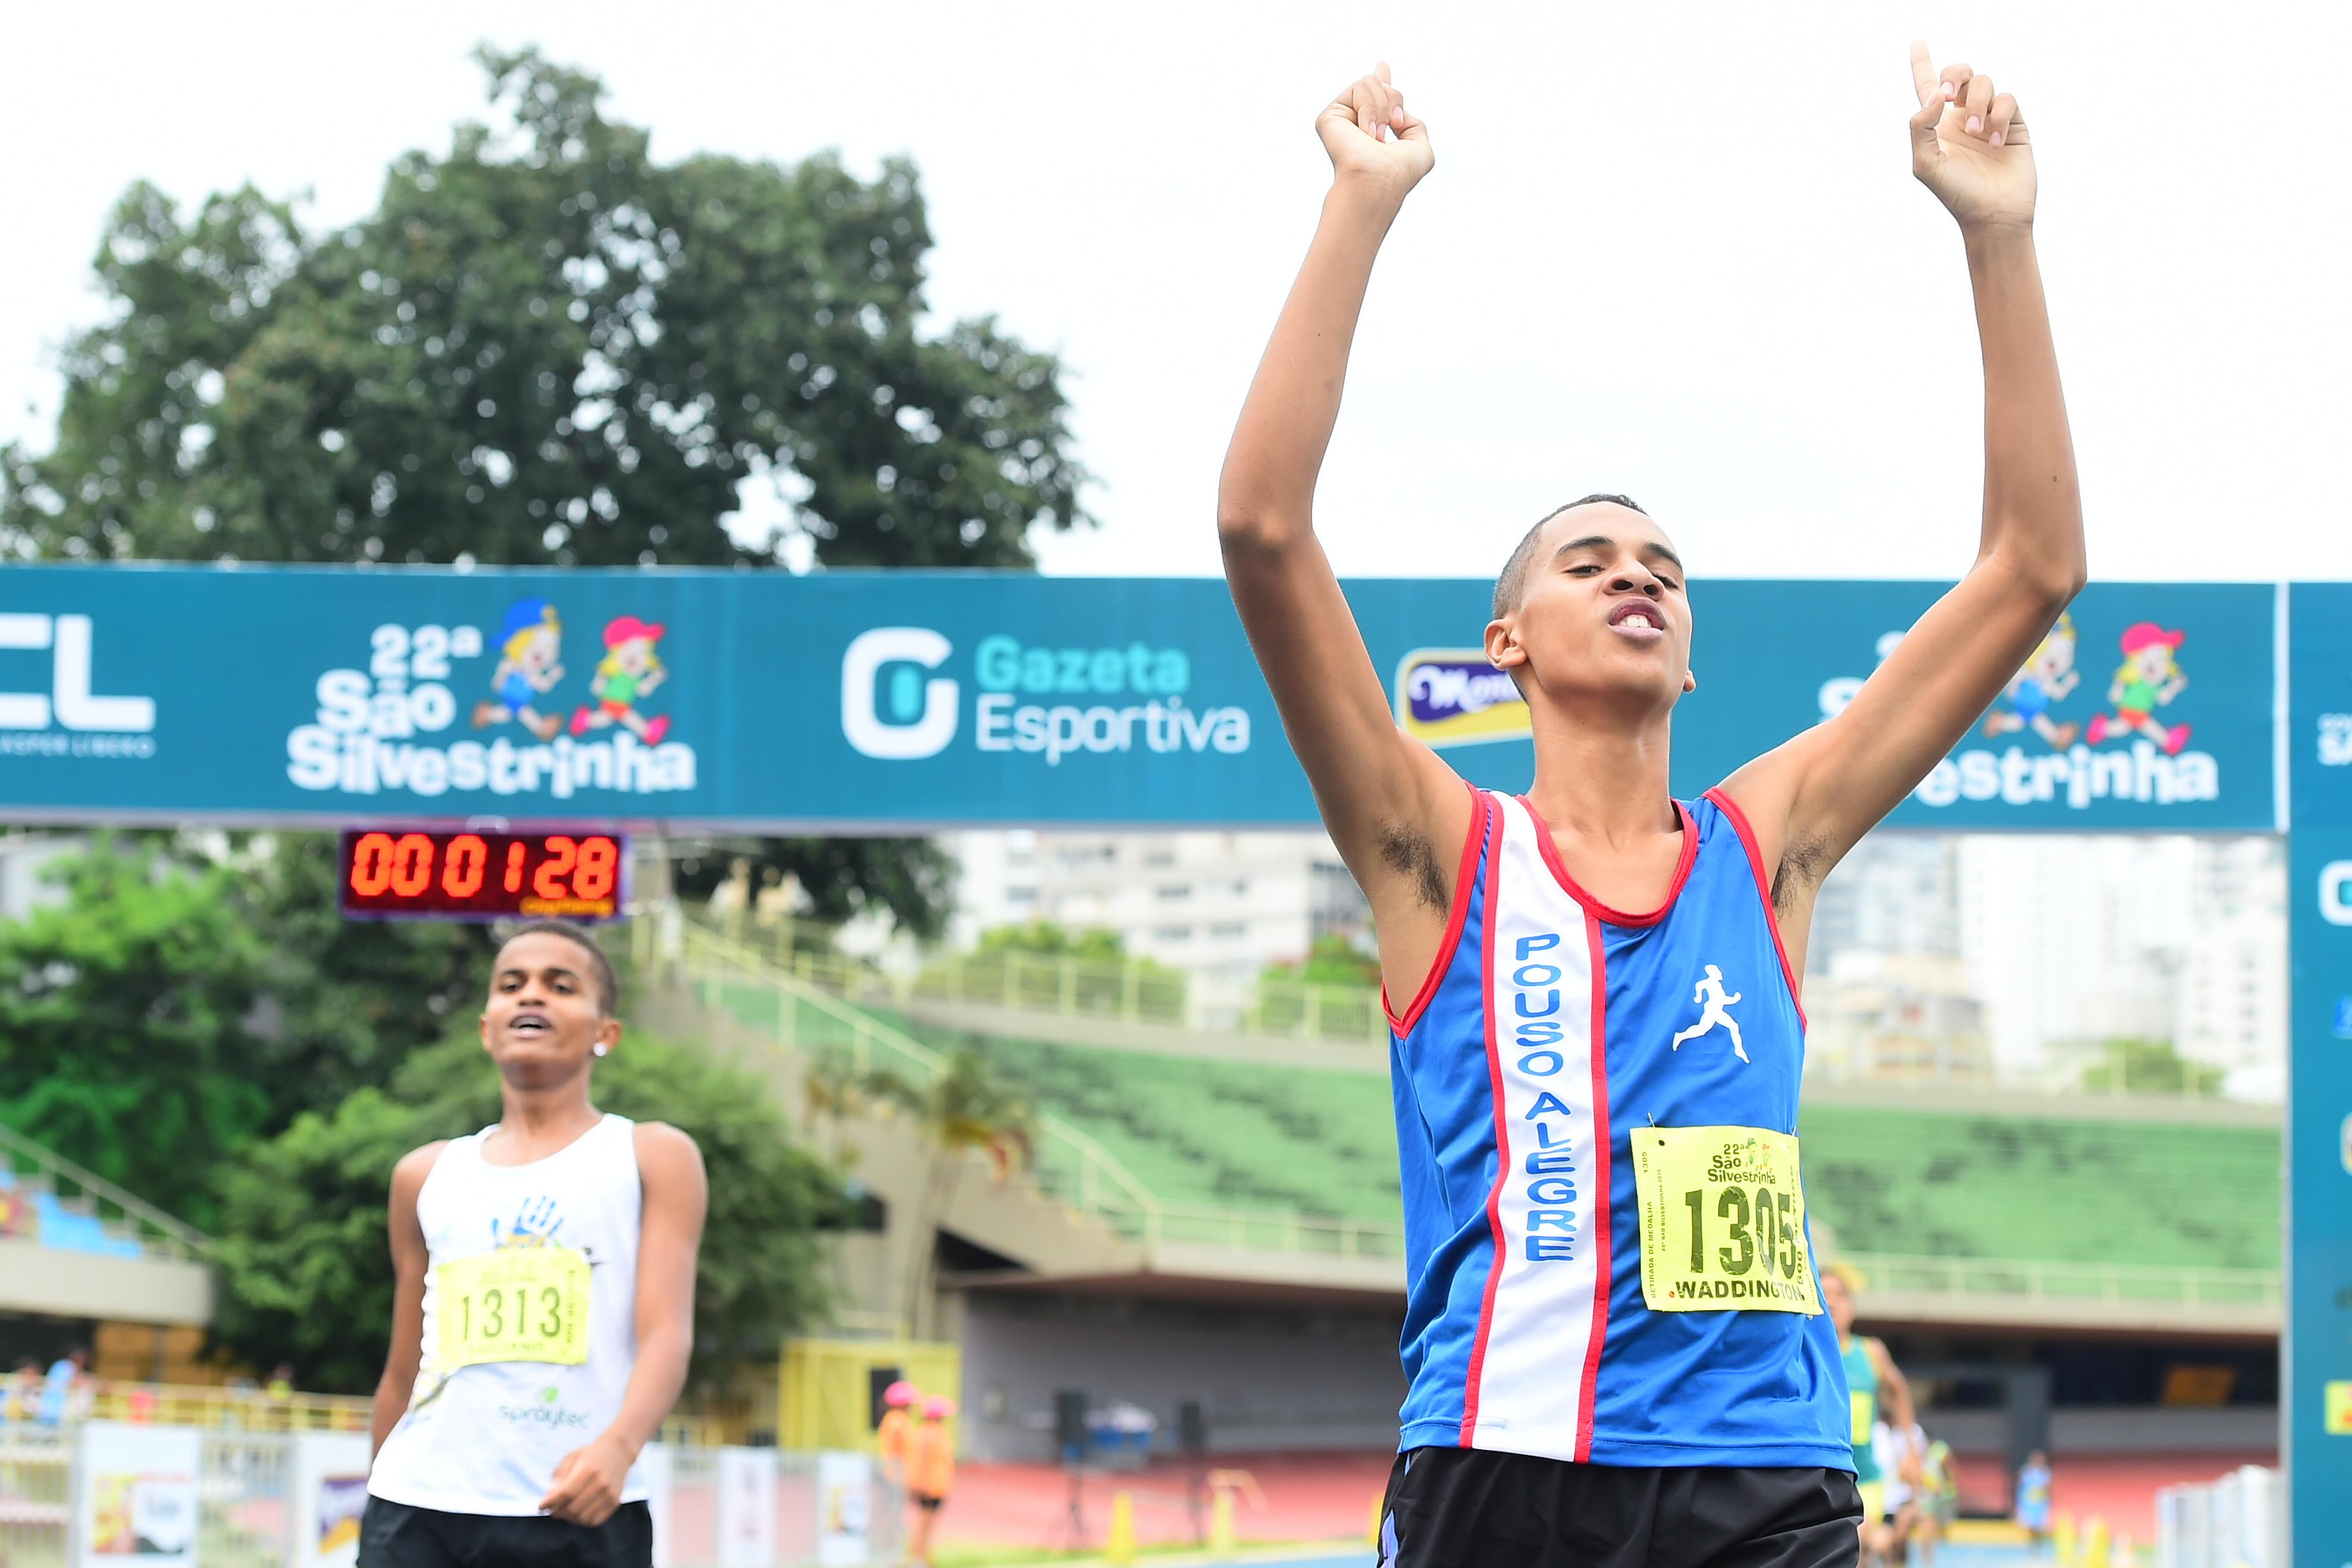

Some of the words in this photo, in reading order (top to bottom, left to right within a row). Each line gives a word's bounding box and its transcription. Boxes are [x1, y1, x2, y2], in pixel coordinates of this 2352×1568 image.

[975, 635, 1191, 694] Gazeta
[315, 669, 456, 739] São
[976, 693, 1251, 766] Esportiva
[286, 729, 697, 798] Silvestrinha
[1911, 740, 2220, 809] estrinha
[1513, 933, 1564, 1076] POUSO
[1525, 1092, 1577, 1261] ALEGRE
[1708, 1169, 1776, 1185] Silvestrinha
[1713, 1155, 1741, 1169] São
[1648, 1244, 1654, 1254] DE
[1686, 1186, 1796, 1280] 1305
[1648, 1257, 1657, 1298] RETIRADA
[1675, 1280, 1804, 1301] WADDINGTON
[462, 1286, 561, 1340] 1313
